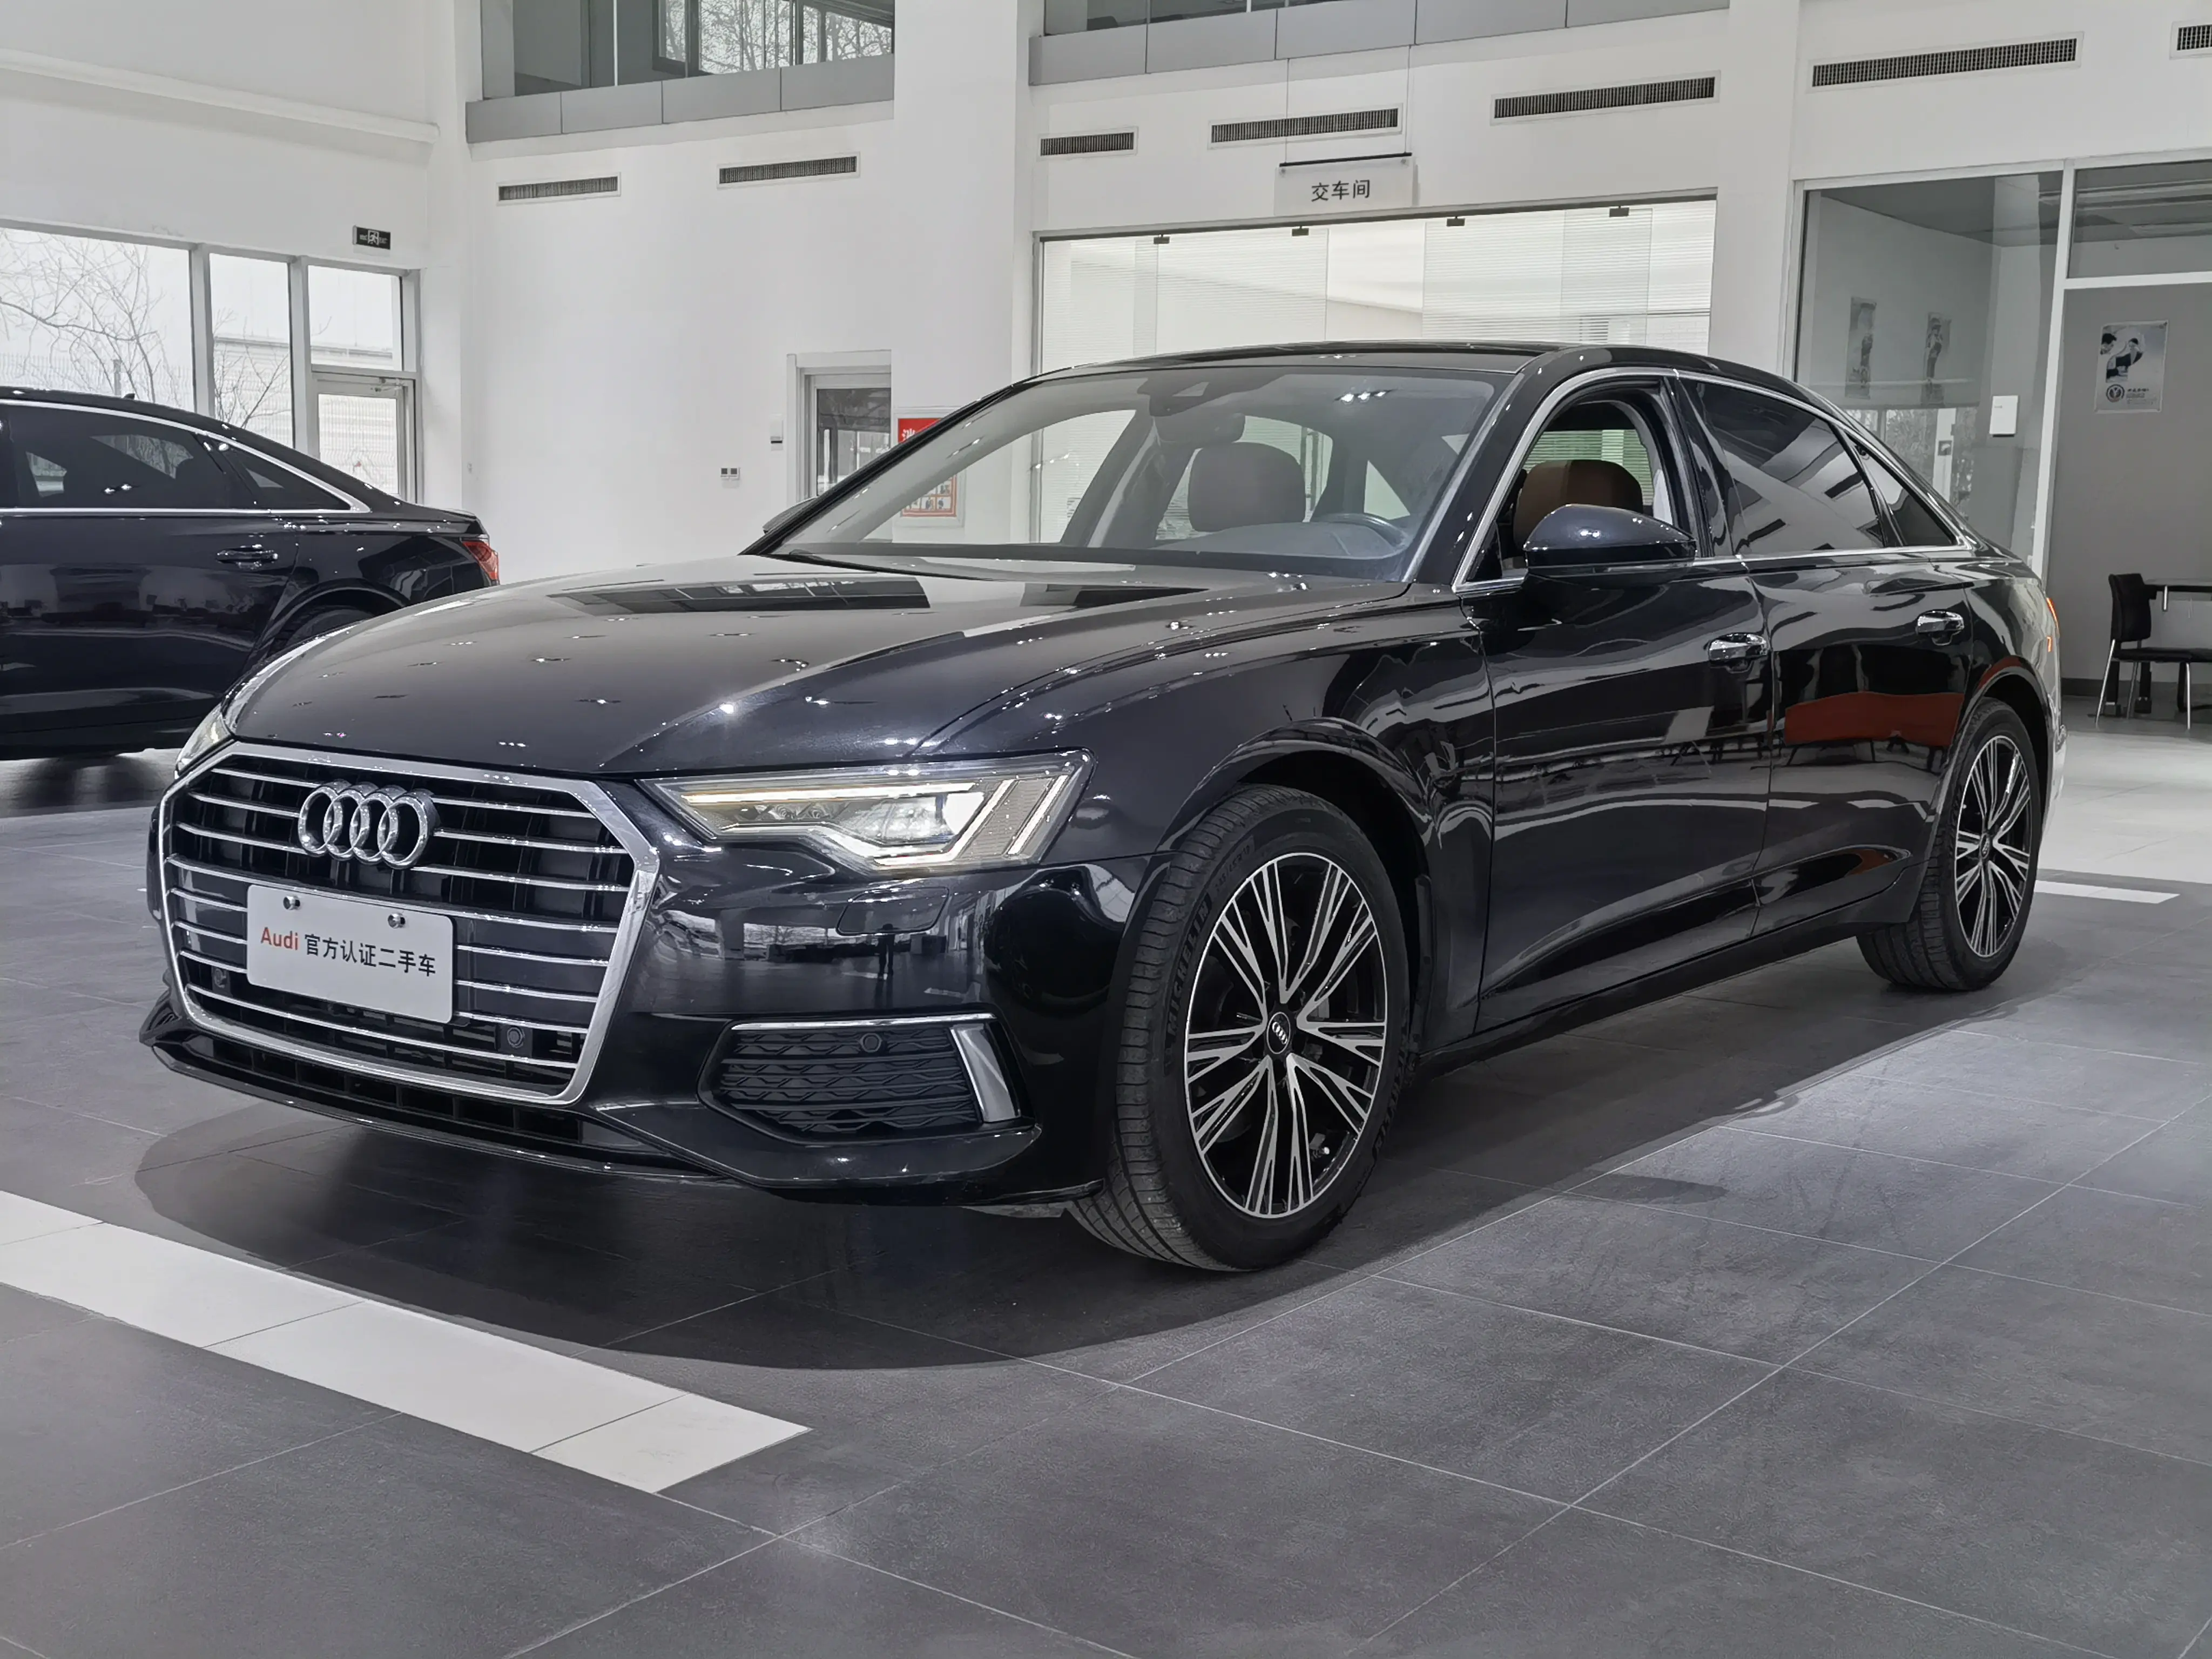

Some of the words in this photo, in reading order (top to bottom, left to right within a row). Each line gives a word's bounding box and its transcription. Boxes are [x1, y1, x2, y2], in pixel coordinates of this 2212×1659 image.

[1311, 179, 1371, 201] 交车间
[261, 927, 299, 950] Audi
[305, 934, 436, 976] 官方认证二手车
[1167, 900, 1209, 1036] MICHELIN
